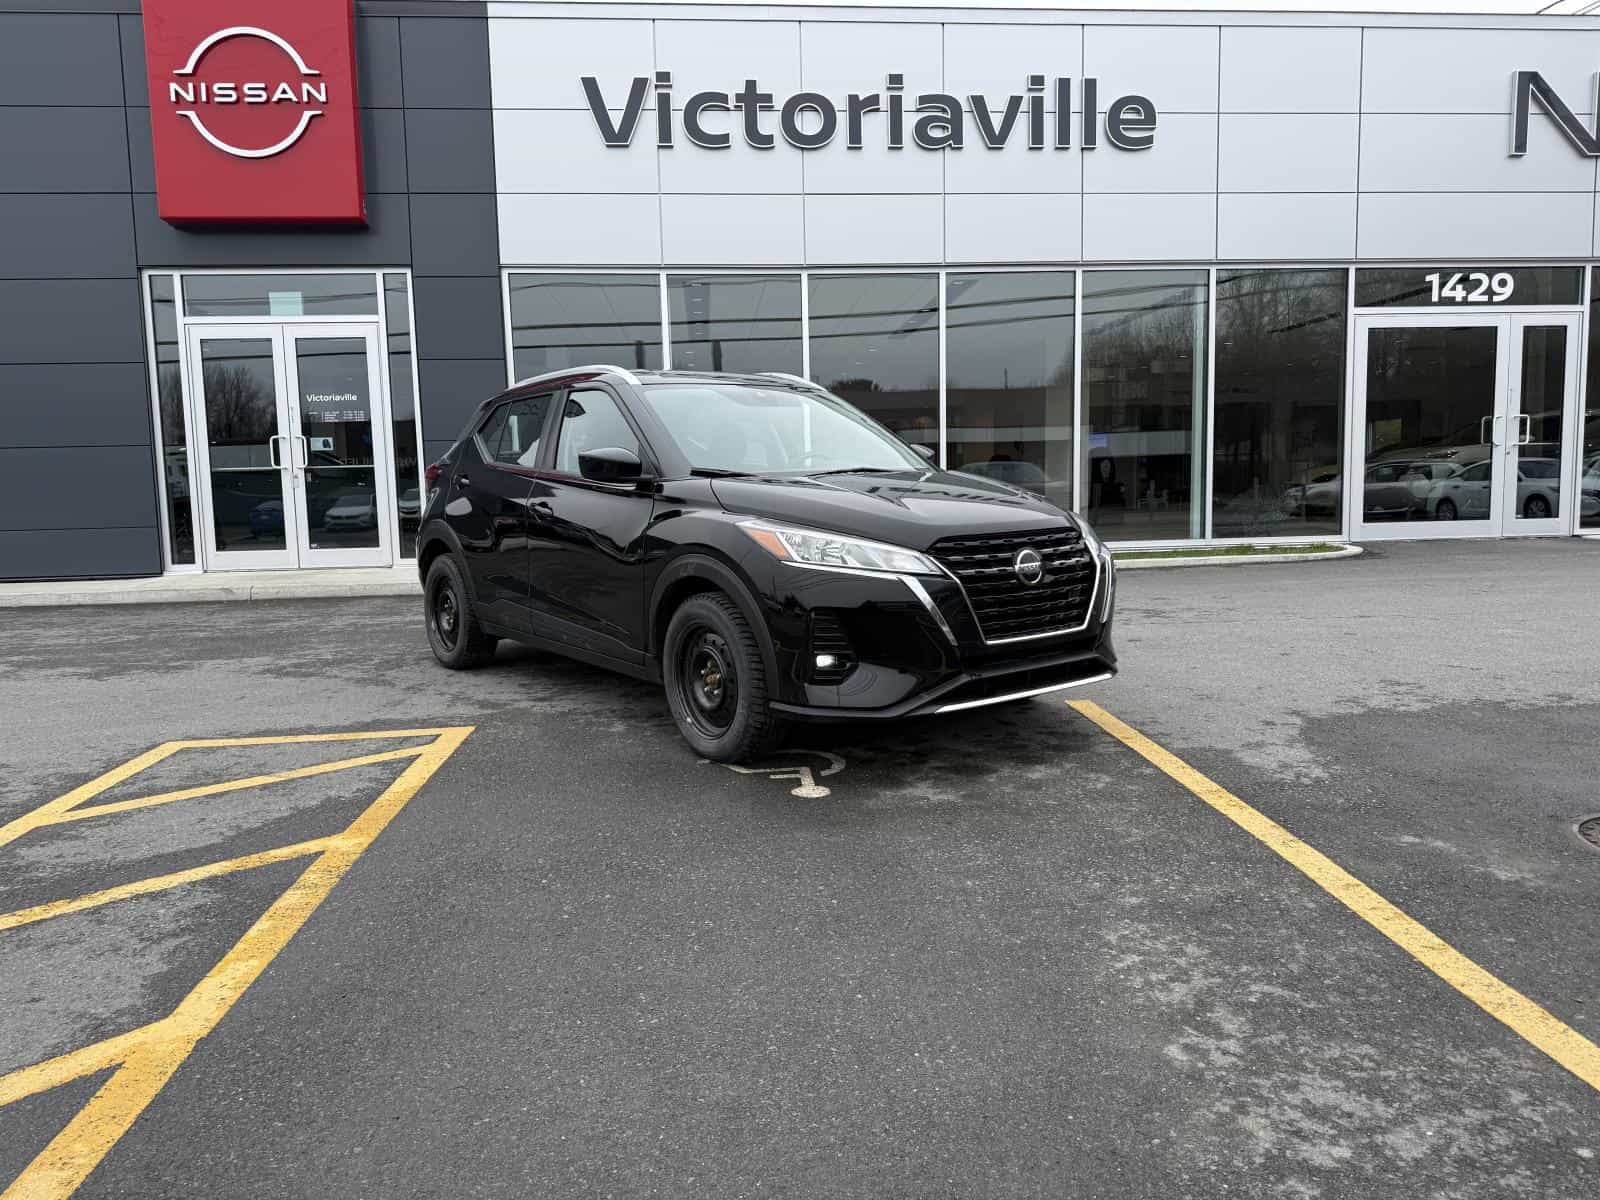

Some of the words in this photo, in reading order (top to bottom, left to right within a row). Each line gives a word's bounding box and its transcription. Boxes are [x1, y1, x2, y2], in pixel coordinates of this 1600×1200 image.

[169, 82, 328, 103] NISSAN
[580, 71, 1158, 151] Victoriaville
[1425, 272, 1515, 303] 1429
[306, 393, 358, 402] Victoriaville
